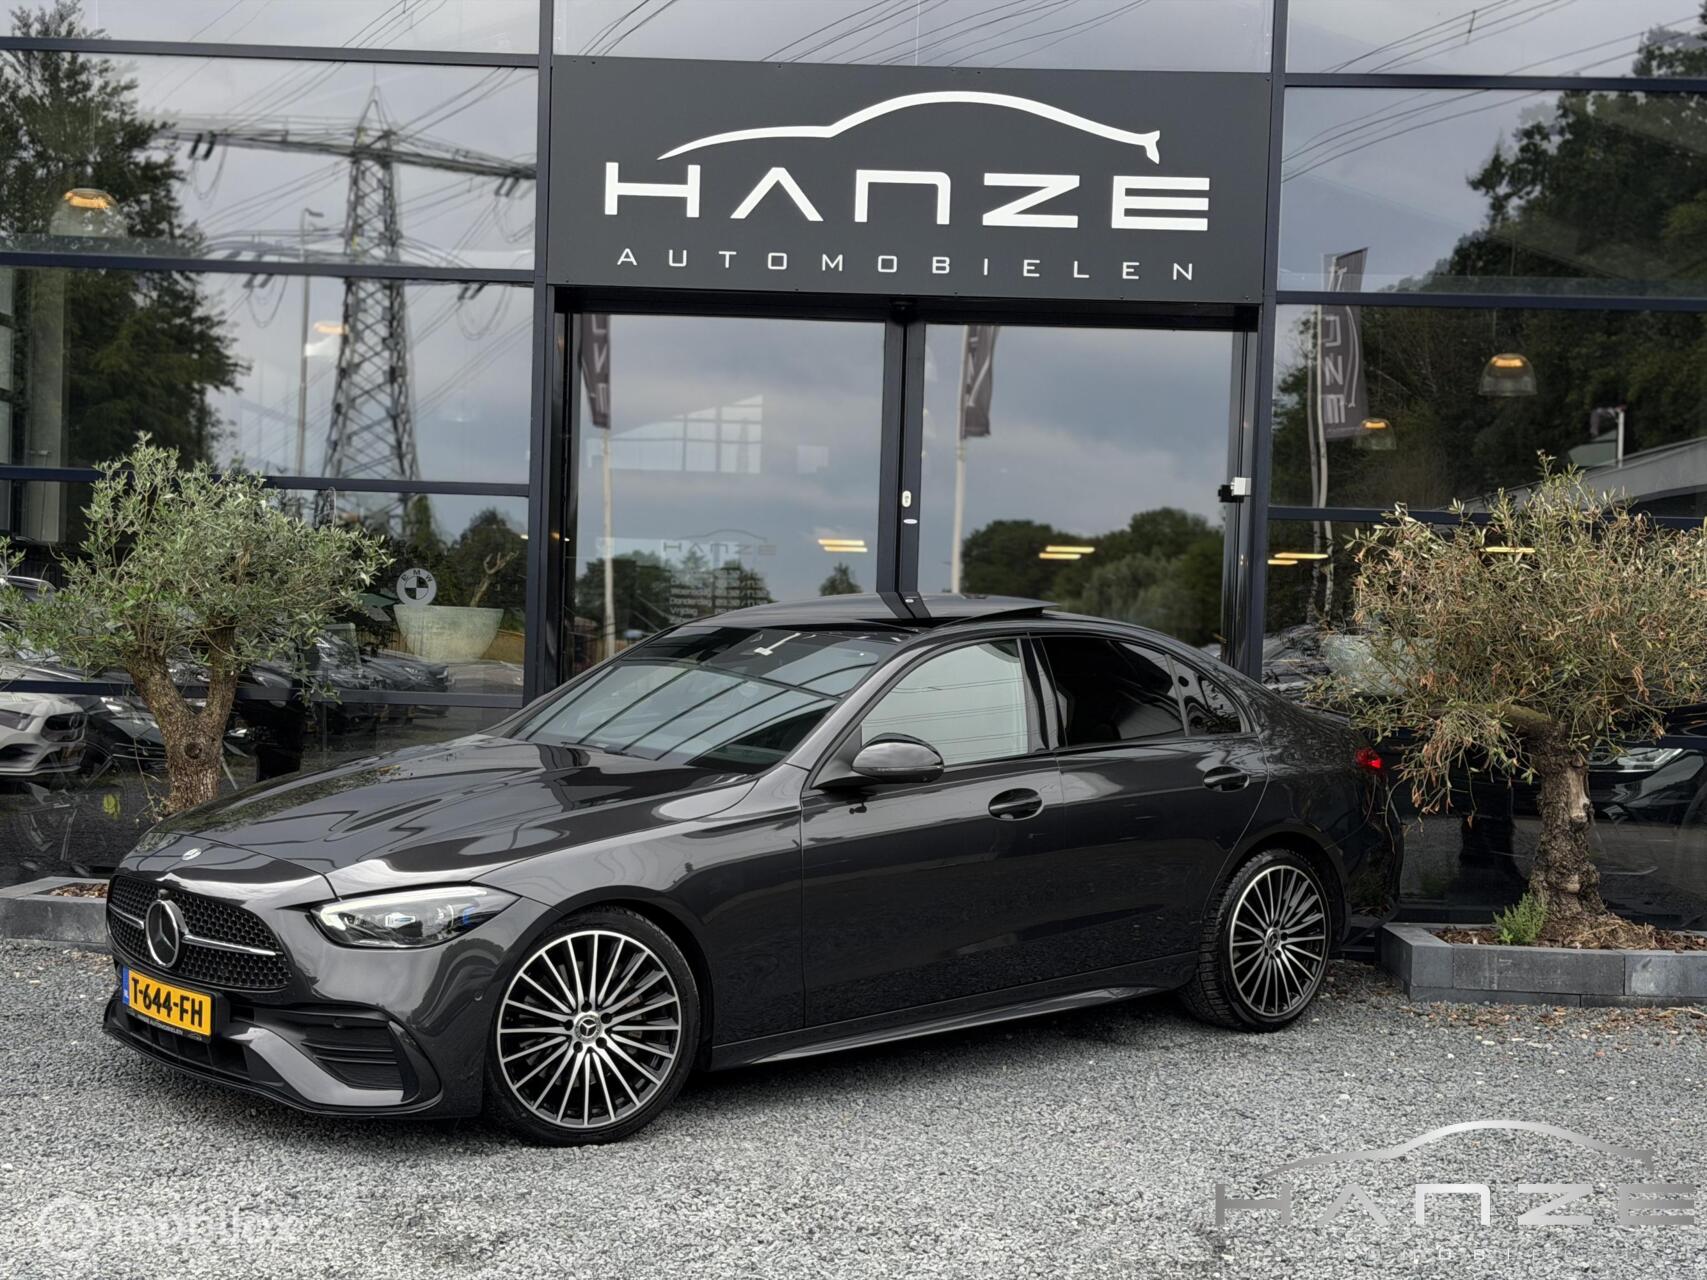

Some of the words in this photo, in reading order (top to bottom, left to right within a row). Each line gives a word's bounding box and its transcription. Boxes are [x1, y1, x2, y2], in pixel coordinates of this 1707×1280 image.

[604, 161, 1211, 231] HANZE
[617, 248, 1194, 281] AUTOMOBIELEN
[401, 569, 433, 582] BMW
[131, 977, 203, 1028] T-644-FH
